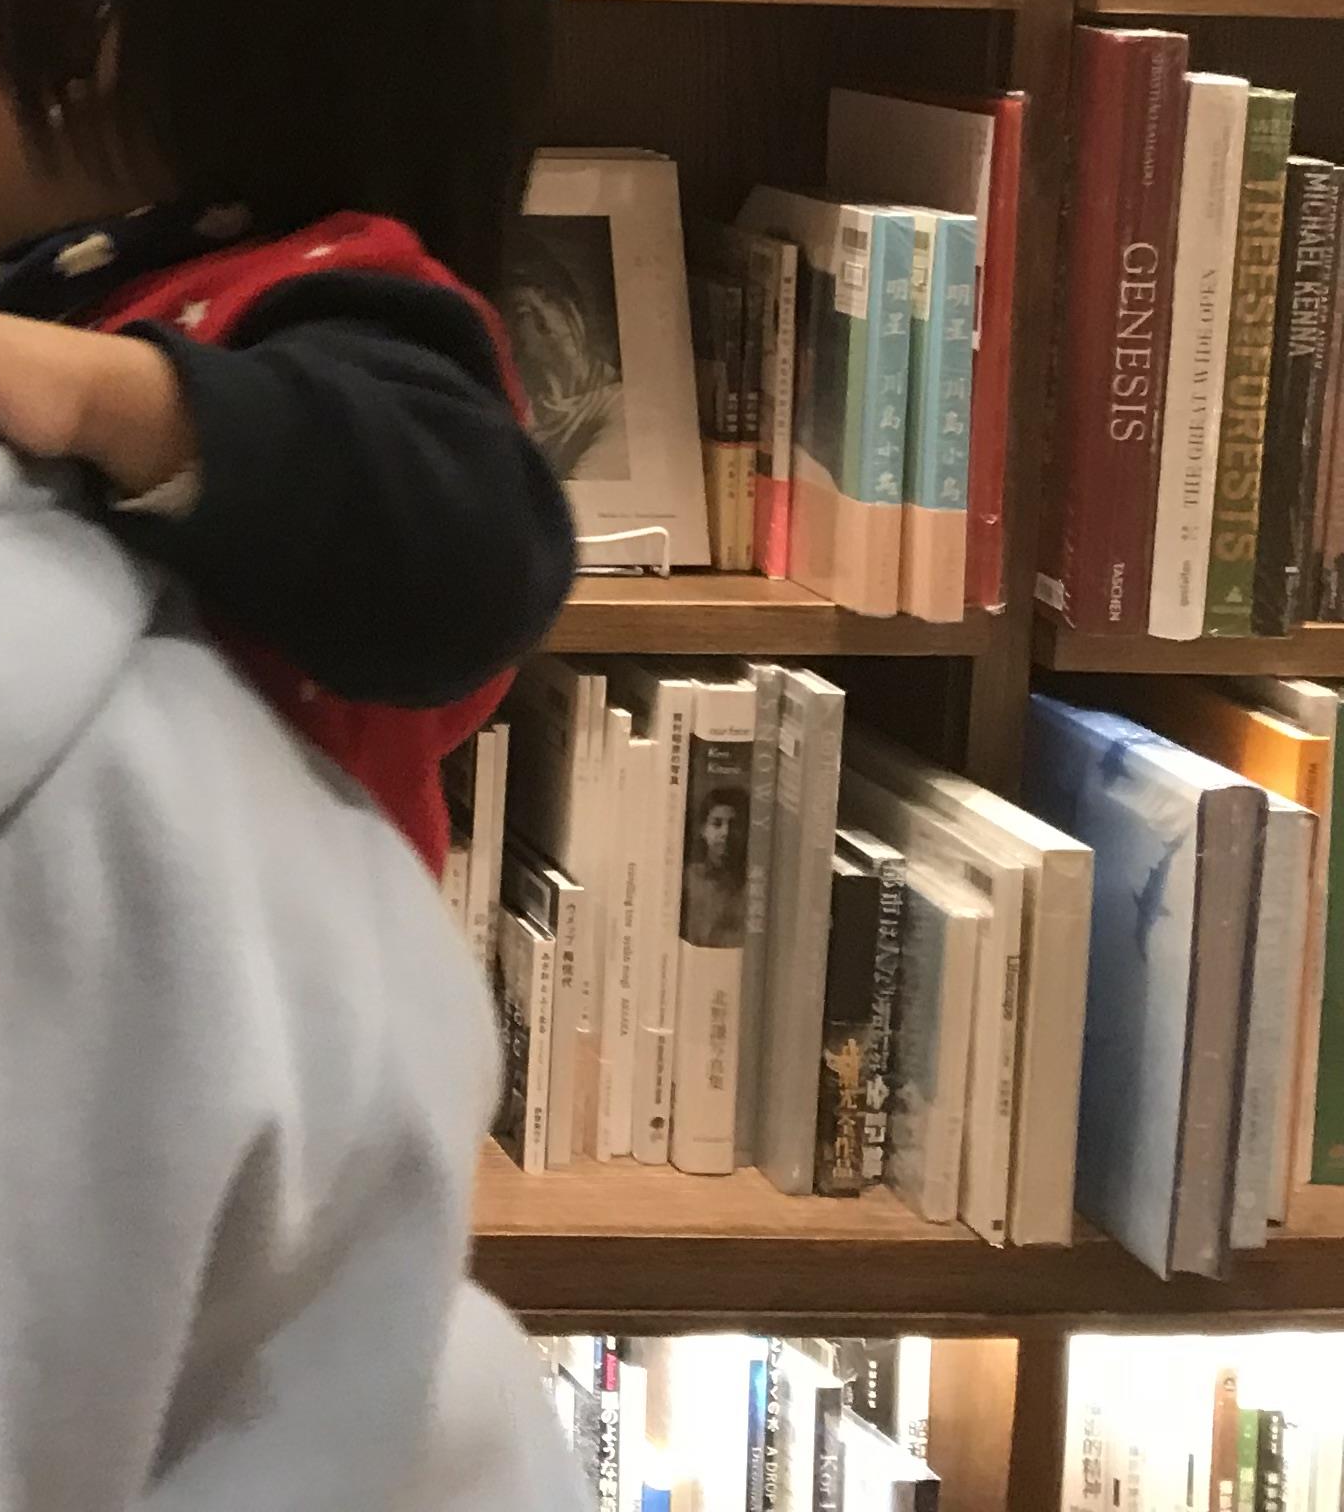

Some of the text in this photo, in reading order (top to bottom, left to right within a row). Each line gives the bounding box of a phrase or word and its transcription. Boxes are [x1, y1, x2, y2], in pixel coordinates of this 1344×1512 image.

[1110, 242, 1160, 443] GENESIS
[1288, 172, 1330, 357] MICHAEL KENNA
[1217, 345, 1272, 564] FORESTS
[1109, 563, 1125, 622] TASCHEN
